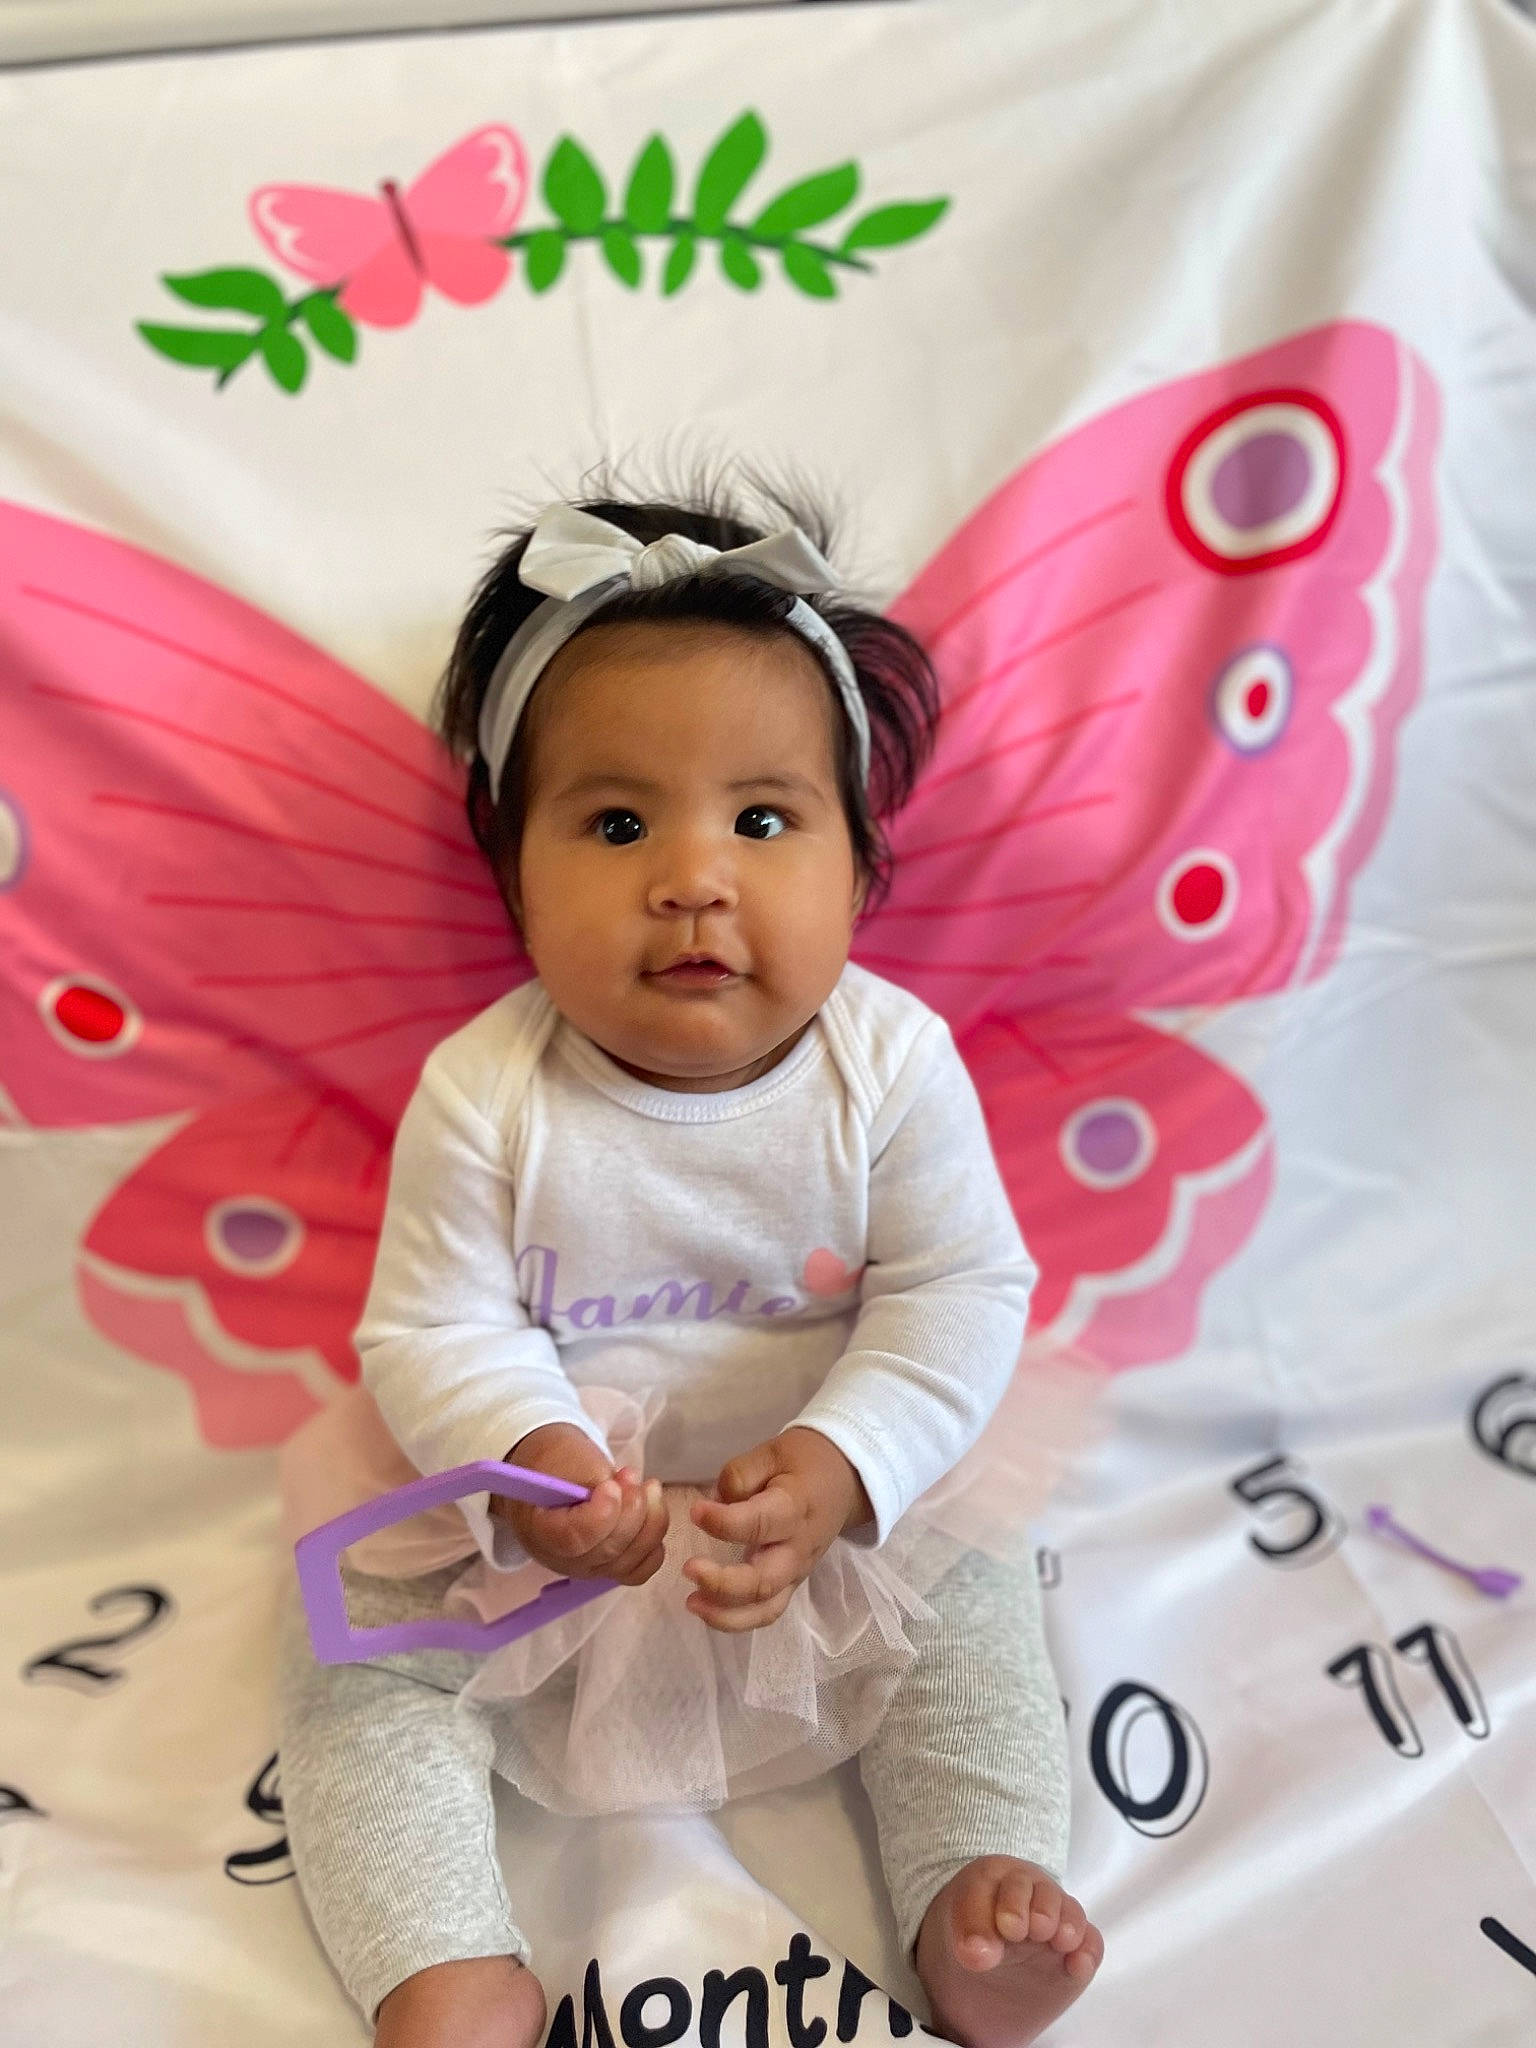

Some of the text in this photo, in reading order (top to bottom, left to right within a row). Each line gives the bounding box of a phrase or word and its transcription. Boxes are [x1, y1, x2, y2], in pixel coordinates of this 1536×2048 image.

[514, 1244, 797, 1329] Jamie
[1230, 1454, 1346, 1568] 5
[24, 1583, 172, 1697] 2
[1326, 1621, 1490, 1758] 11
[1063, 1680, 1209, 1838] 0
